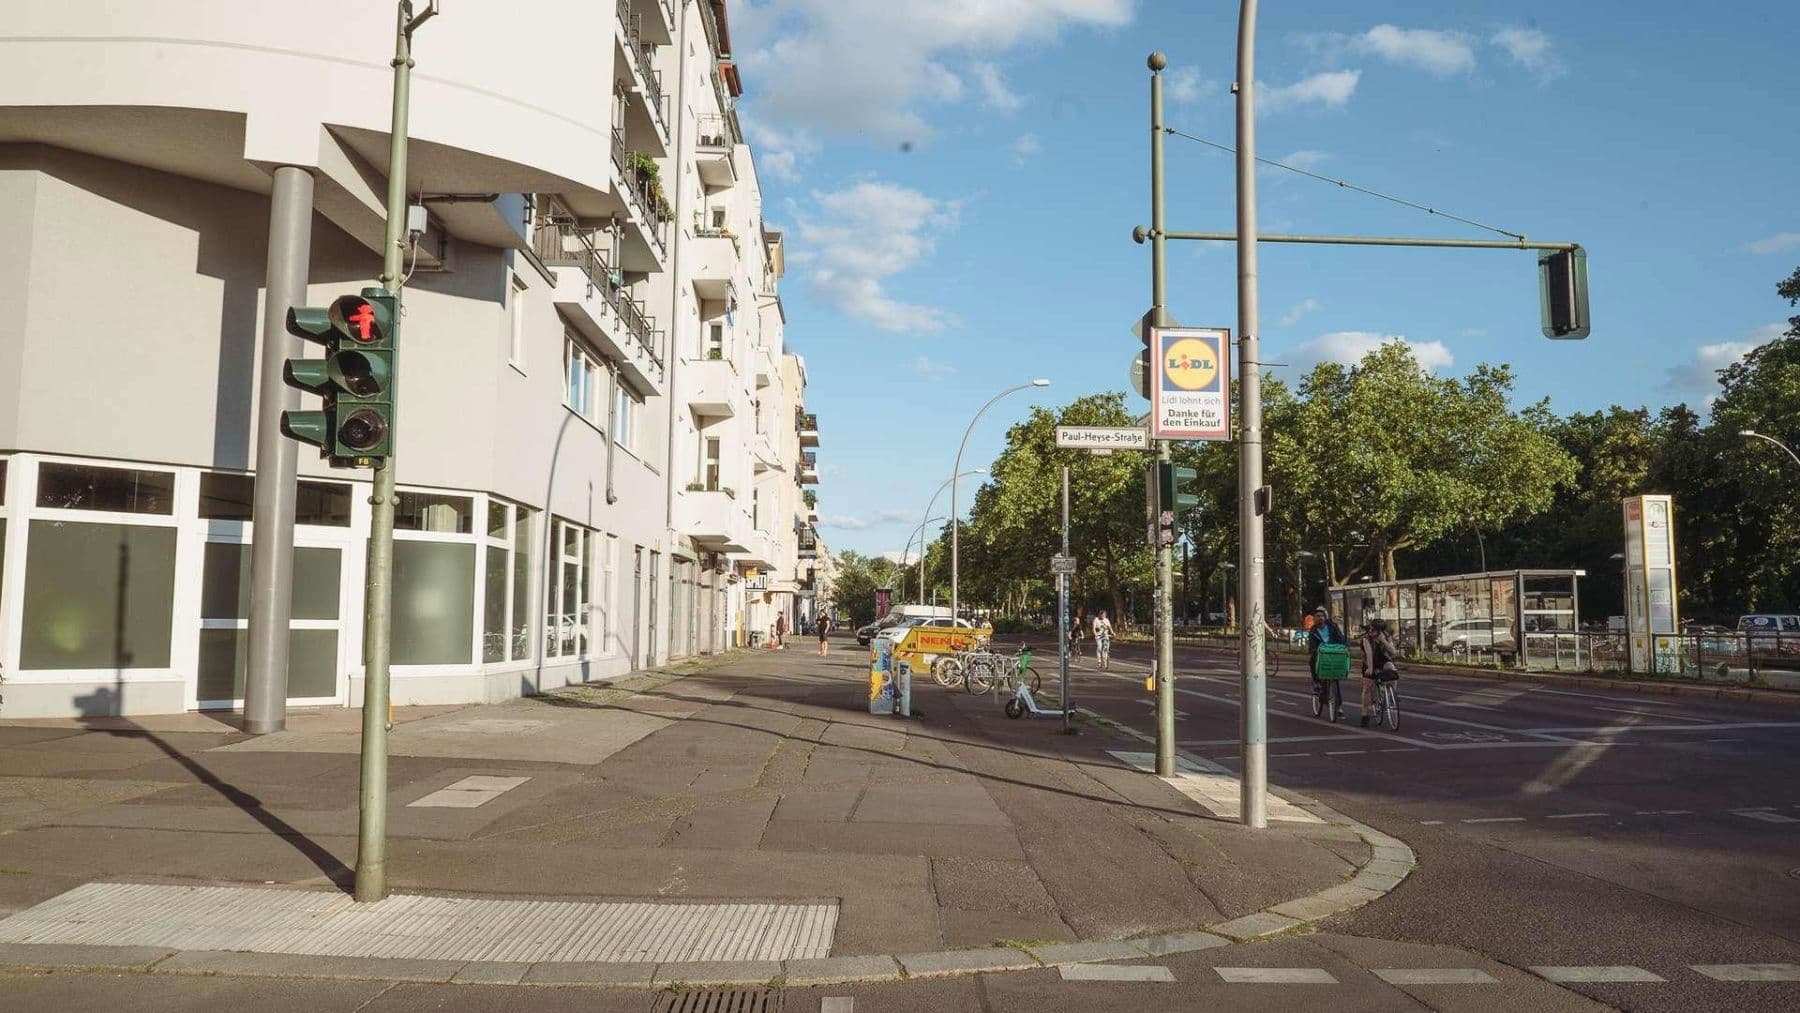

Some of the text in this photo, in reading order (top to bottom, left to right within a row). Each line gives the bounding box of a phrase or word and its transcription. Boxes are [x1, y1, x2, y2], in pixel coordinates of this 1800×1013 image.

[1161, 396, 1221, 404] Lidl lohnt sich
[1168, 409, 1216, 417] Danke für
[1162, 418, 1221, 427] den Einkauf
[1062, 431, 1143, 444] Paul-Heyse-Straße
